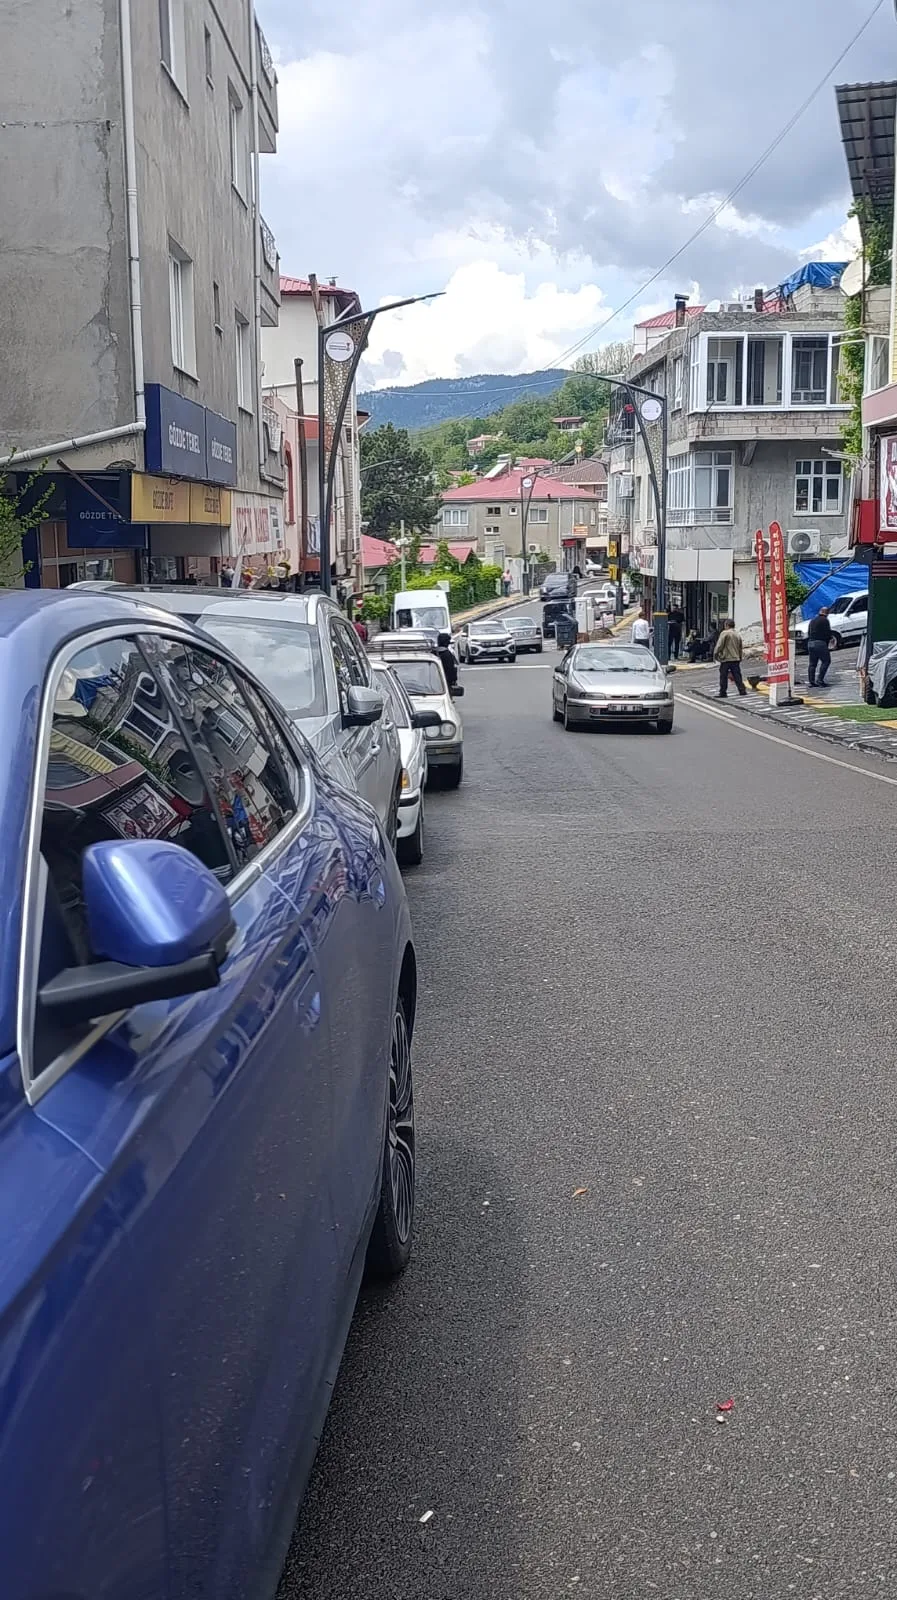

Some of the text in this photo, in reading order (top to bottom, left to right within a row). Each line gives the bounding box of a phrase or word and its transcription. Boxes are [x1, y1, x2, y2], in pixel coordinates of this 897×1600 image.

[168, 421, 201, 454] GÖZDE TEKEL
[80, 510, 106, 520] GÖZDE
